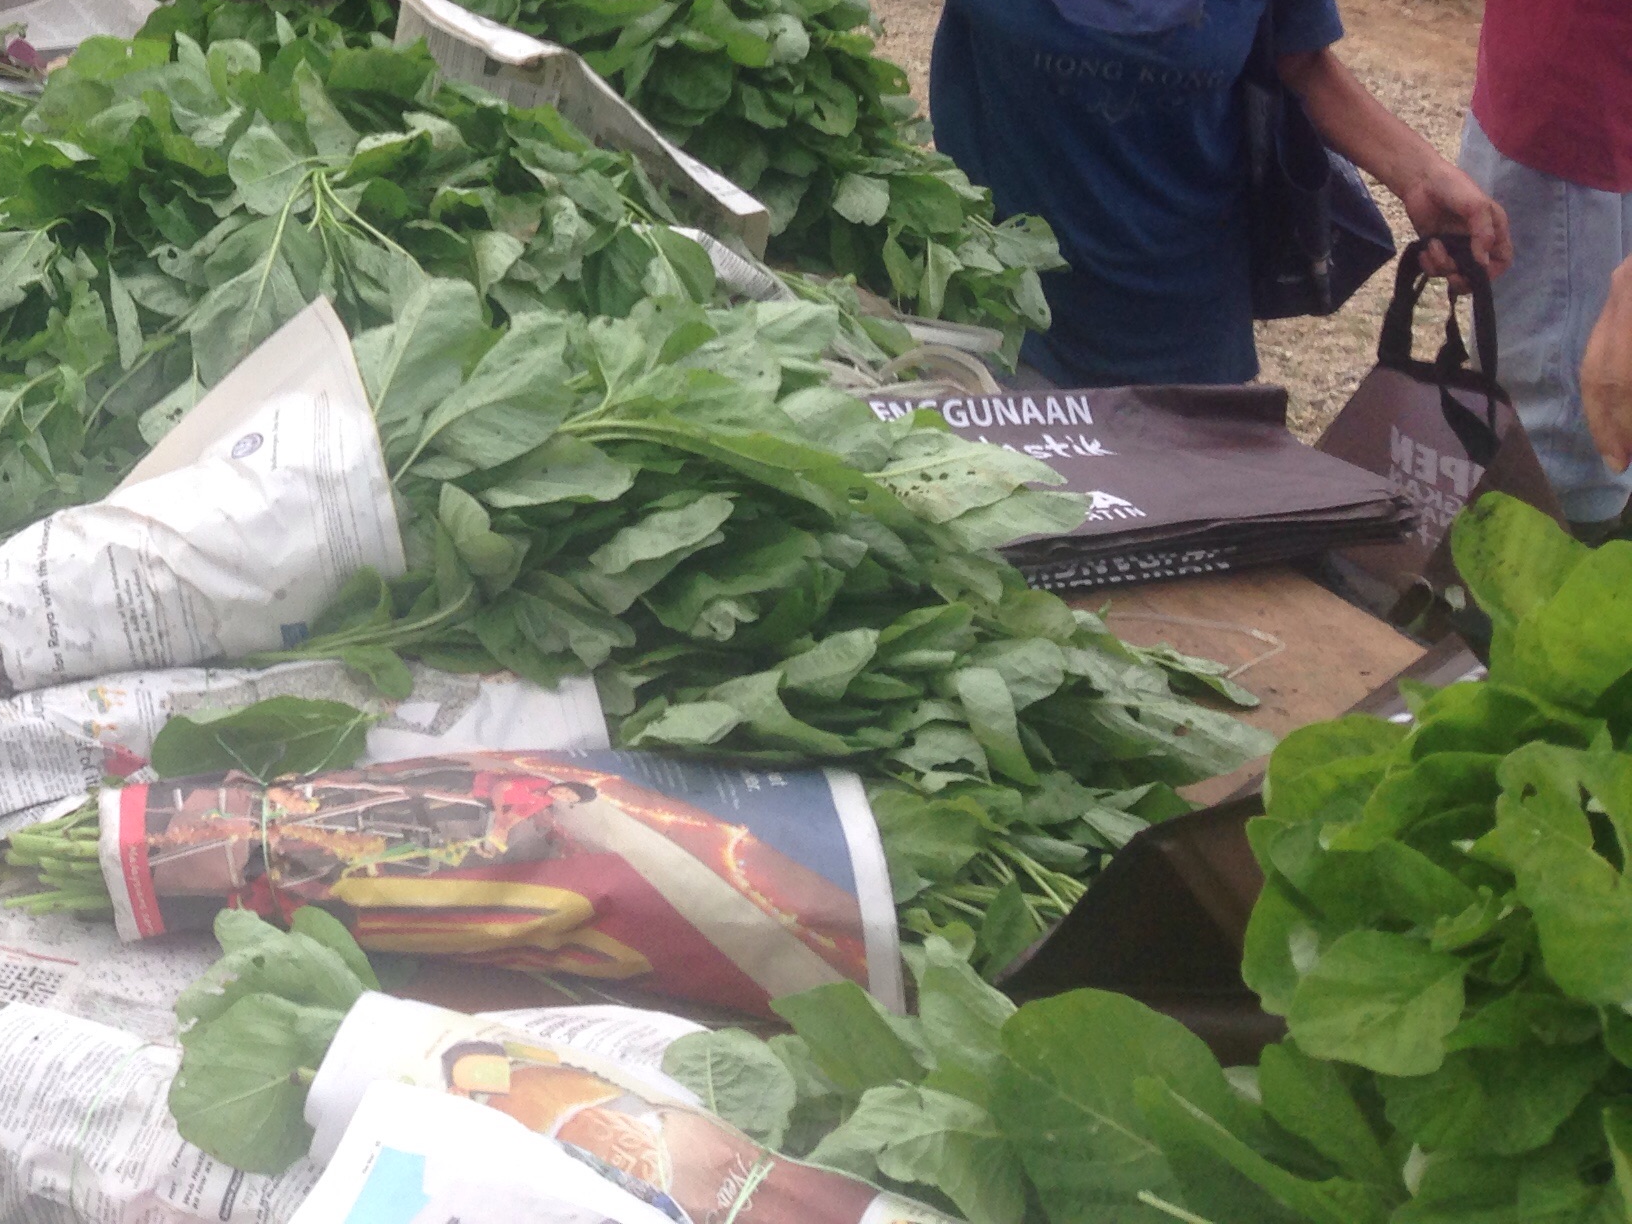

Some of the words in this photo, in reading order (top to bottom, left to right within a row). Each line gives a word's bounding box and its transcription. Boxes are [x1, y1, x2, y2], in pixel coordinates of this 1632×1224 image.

[870, 396, 1094, 428] ENGUNAAN
[35, 558, 48, 578] the
[38, 579, 52, 608] with
[46, 612, 60, 648] Raya
